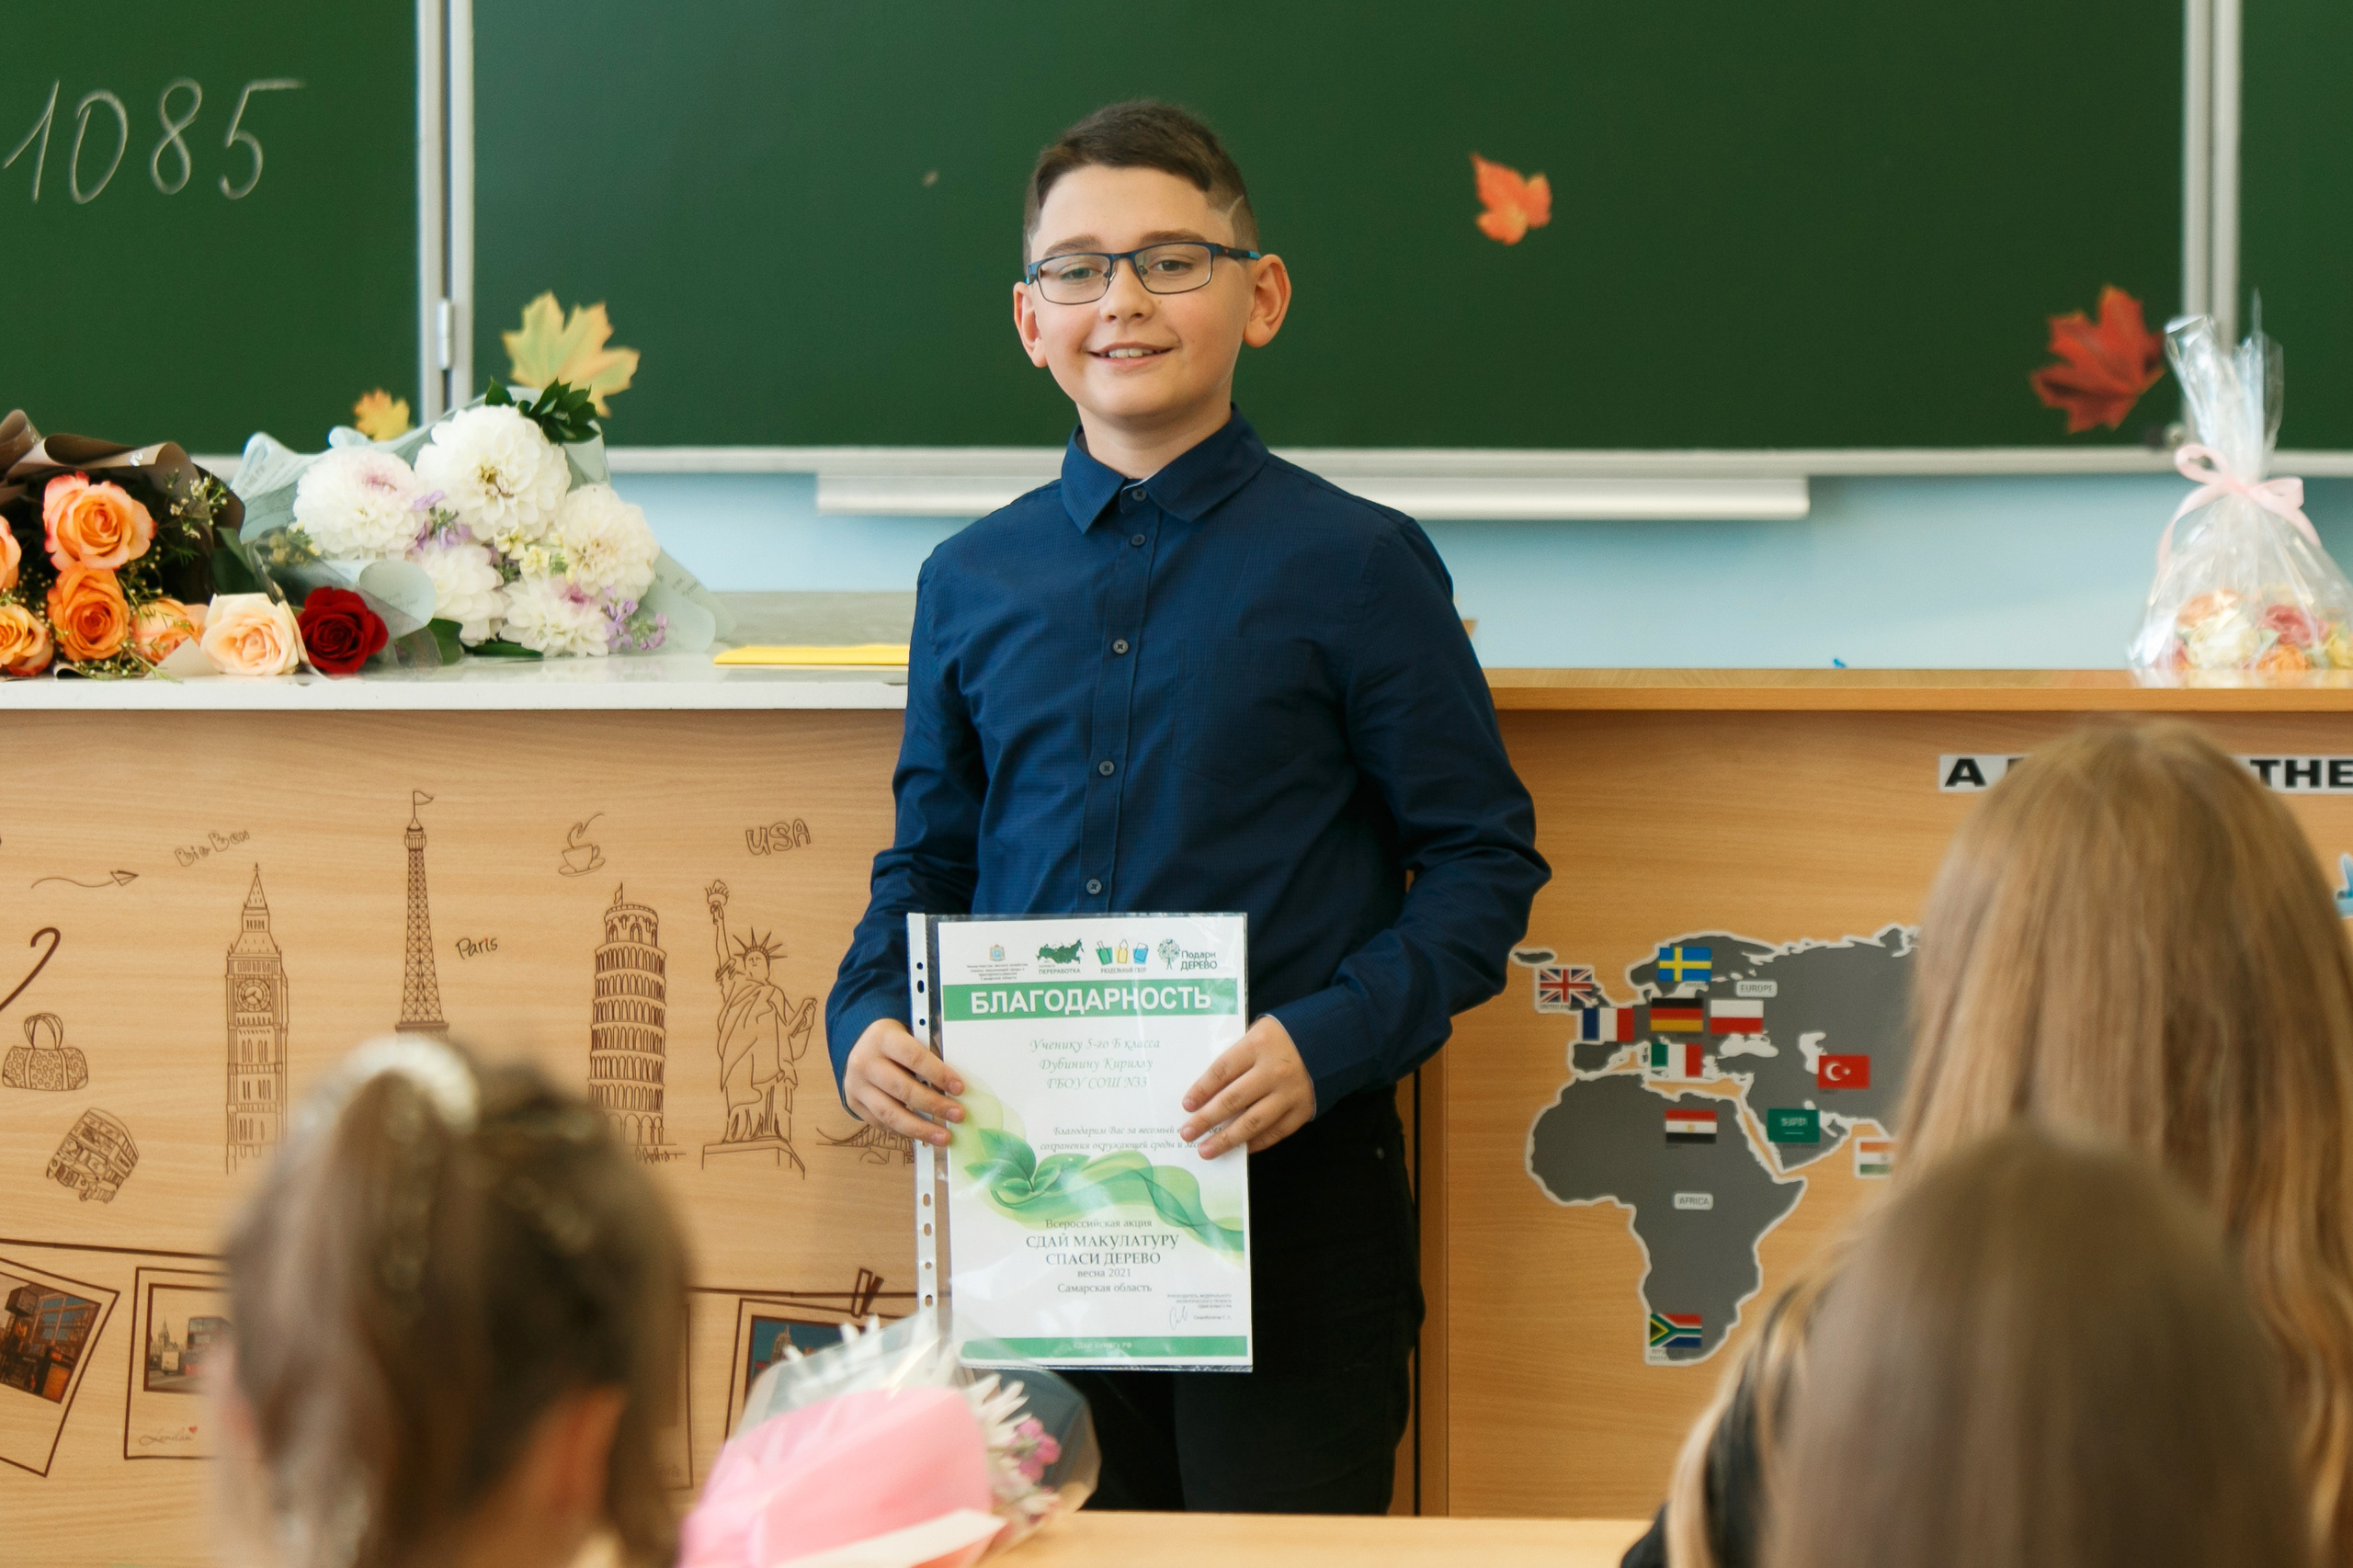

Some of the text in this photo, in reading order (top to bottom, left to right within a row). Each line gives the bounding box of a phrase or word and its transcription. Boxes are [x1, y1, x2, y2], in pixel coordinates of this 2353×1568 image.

[3, 76, 305, 203] 1085
[1944, 757, 1987, 787] A
[745, 819, 811, 856] USA
[455, 937, 498, 960] Paris
[1181, 950, 1217, 960] Подари
[1180, 960, 1218, 971] ДЕРЕВО
[1741, 984, 1773, 994] EUROPE
[971, 986, 1212, 1015] БЛАГОДАРНОСТЬ
[1030, 1038, 1161, 1053] Ученику 5-го Б класса
[1040, 1057, 1154, 1074] Дубинину Кириллу
[1046, 1077, 1087, 1090] ГБОУ
[1088, 1076, 1122, 1089] СОШ
[1053, 1126, 1107, 1138] Благодарим
[1108, 1126, 1125, 1135] Вас
[1040, 1142, 1090, 1153] сохранения
[1092, 1141, 1149, 1153] окружающей
[1150, 1141, 1176, 1151] среды
[1679, 1197, 1710, 1205] AFRICA
[1045, 1220, 1153, 1230] Всероссийская акция
[1026, 1233, 1179, 1250] СДАЙ МАКУЛАТУРУ
[1046, 1252, 1161, 1266] СПАСИ ДЕРЕВО
[1108, 1268, 1131, 1278] 2021
[1057, 1282, 1153, 1294] Самарская область
